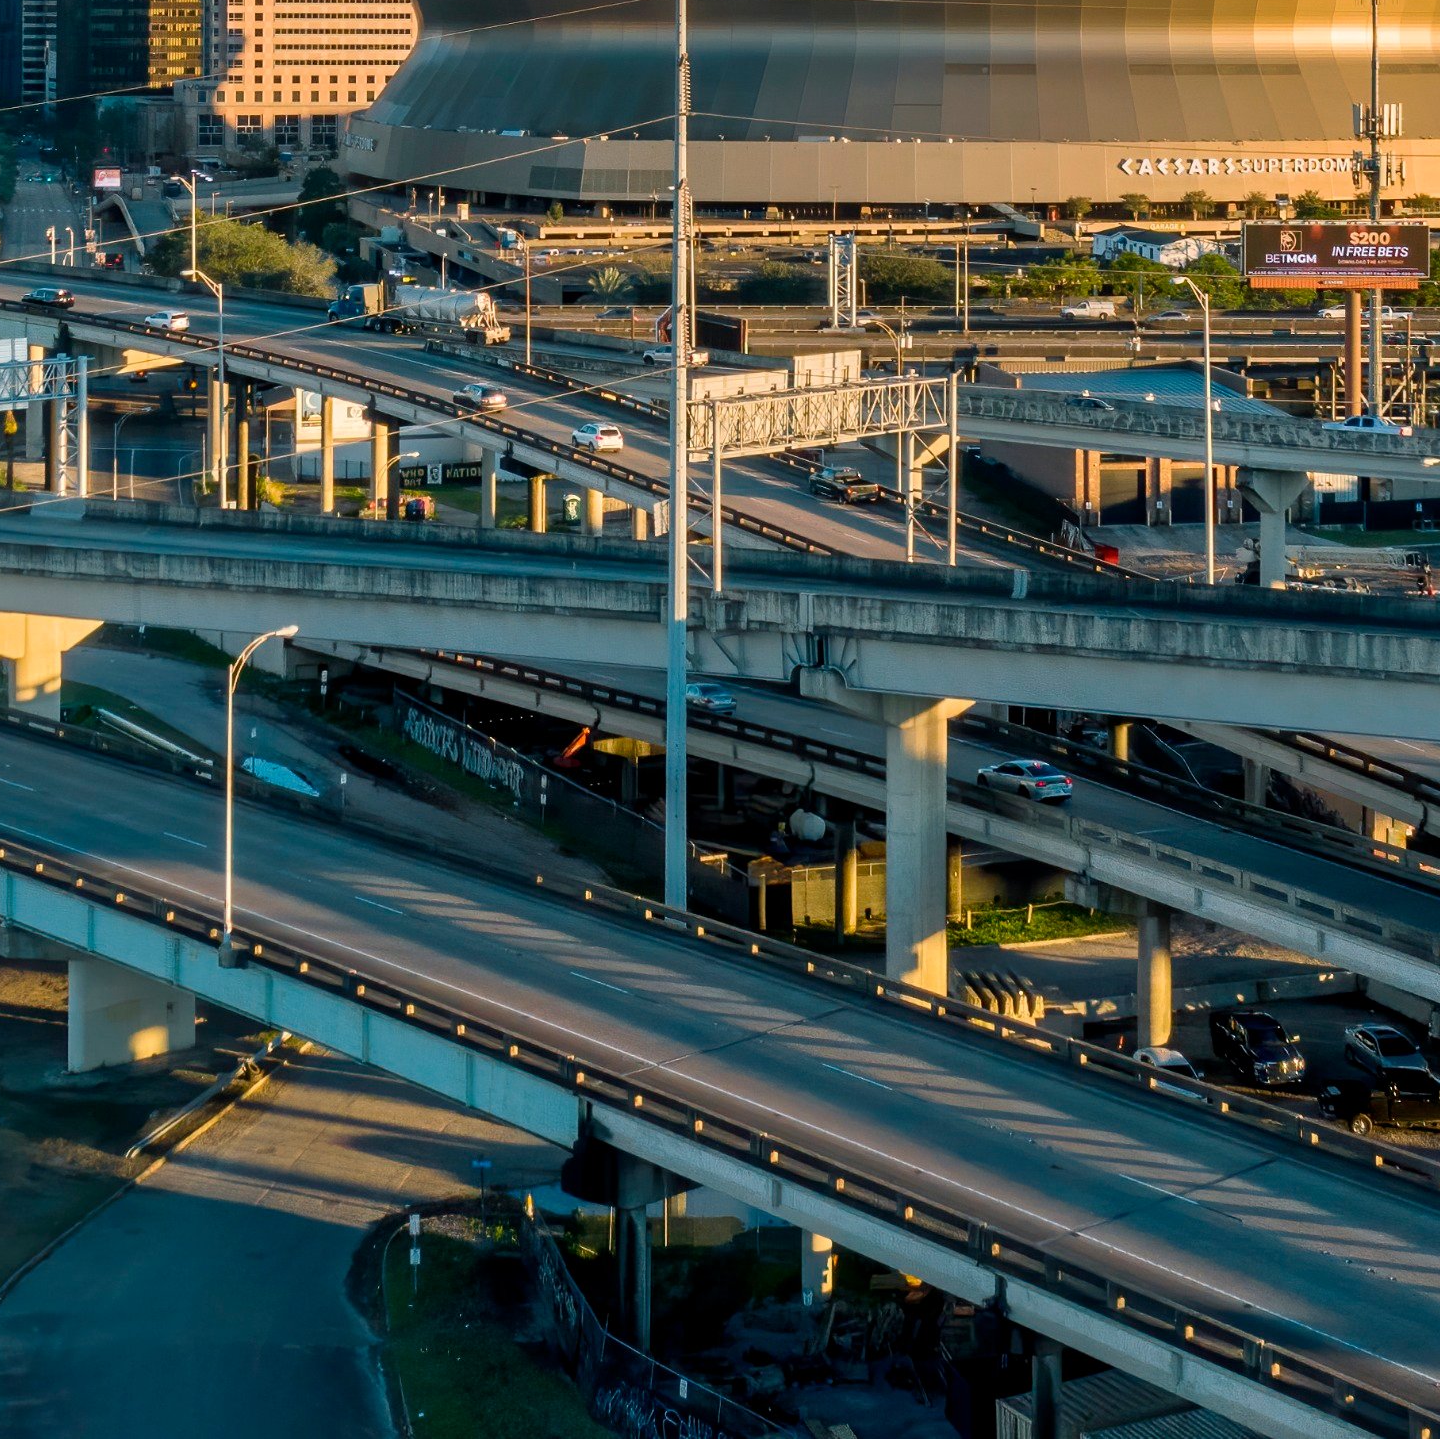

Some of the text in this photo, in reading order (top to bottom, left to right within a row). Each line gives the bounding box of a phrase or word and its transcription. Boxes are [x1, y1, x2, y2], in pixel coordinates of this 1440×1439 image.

[1121, 157, 1359, 175] CAESARS SUPERDOM
[1349, 231, 1391, 246] $200
[1332, 246, 1409, 258] IN FREE BETS
[1265, 254, 1317, 264] BETMGM
[401, 468, 425, 478] WHO
